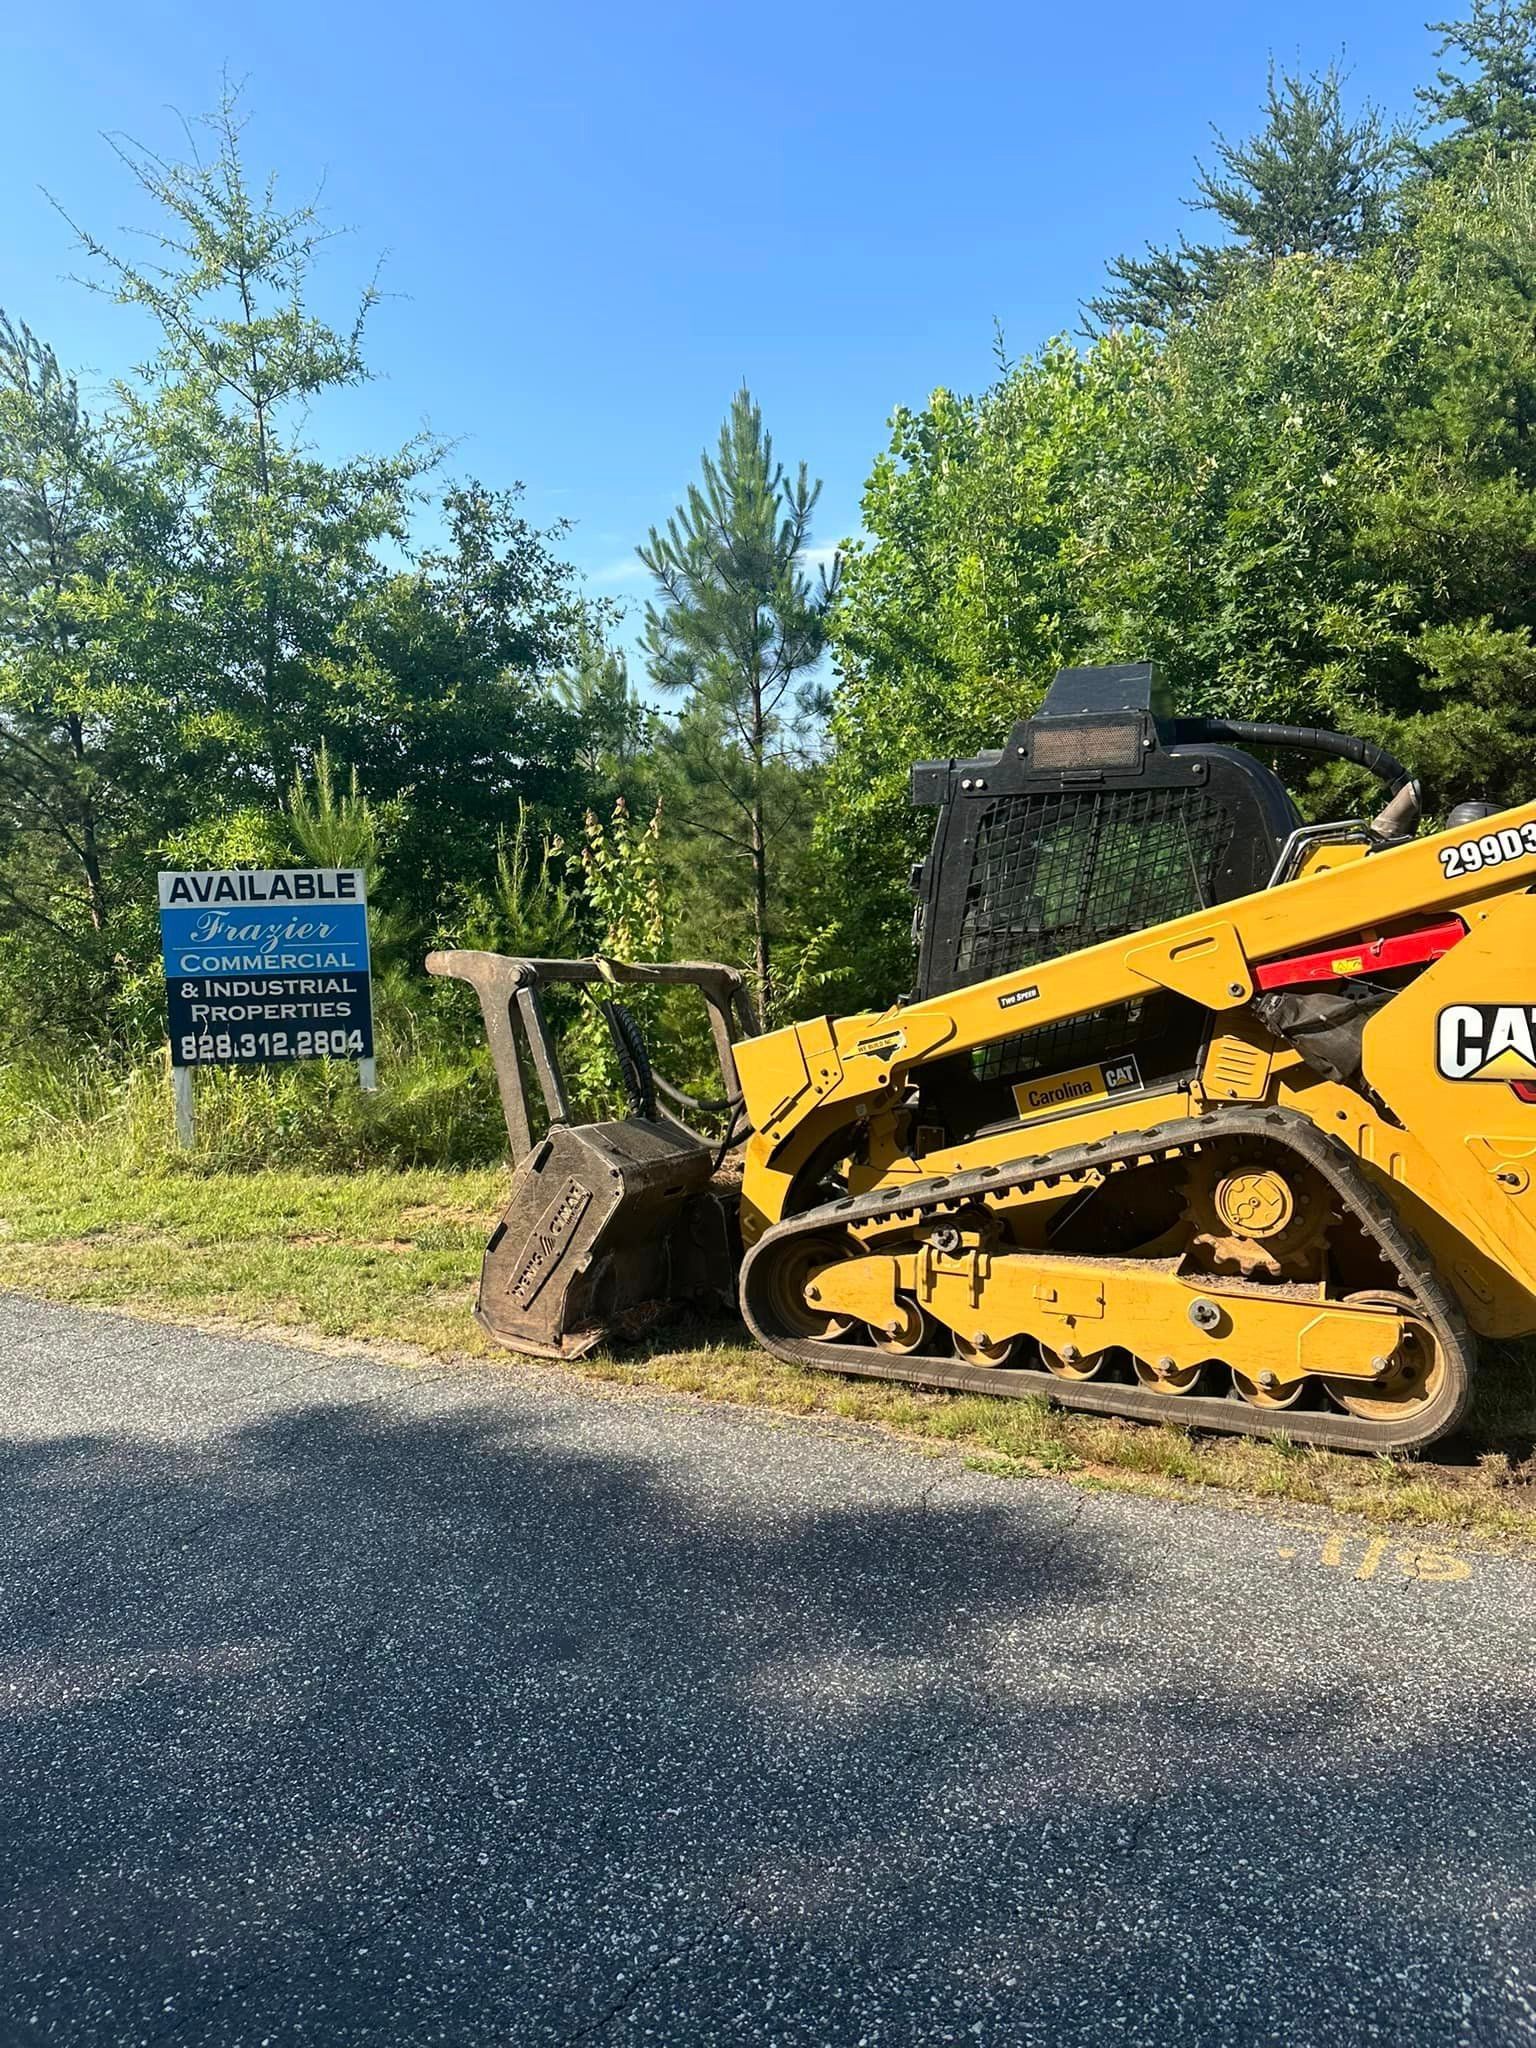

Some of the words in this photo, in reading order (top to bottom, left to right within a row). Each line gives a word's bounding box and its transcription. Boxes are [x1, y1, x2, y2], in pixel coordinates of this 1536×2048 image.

[169, 873, 356, 903] AVAILABLE
[190, 910, 338, 954] Frazier
[180, 952, 356, 972] COMMERCIAL
[181, 983, 199, 998] &
[205, 978, 357, 998] INDUSTRIAL
[191, 1002, 351, 1022] PROPERTIES
[181, 1030, 364, 1060] 828.312.2804
[1439, 1005, 1536, 1079] CA
[1028, 1081, 1093, 1107] Carolina
[1105, 1065, 1134, 1087] CAT
